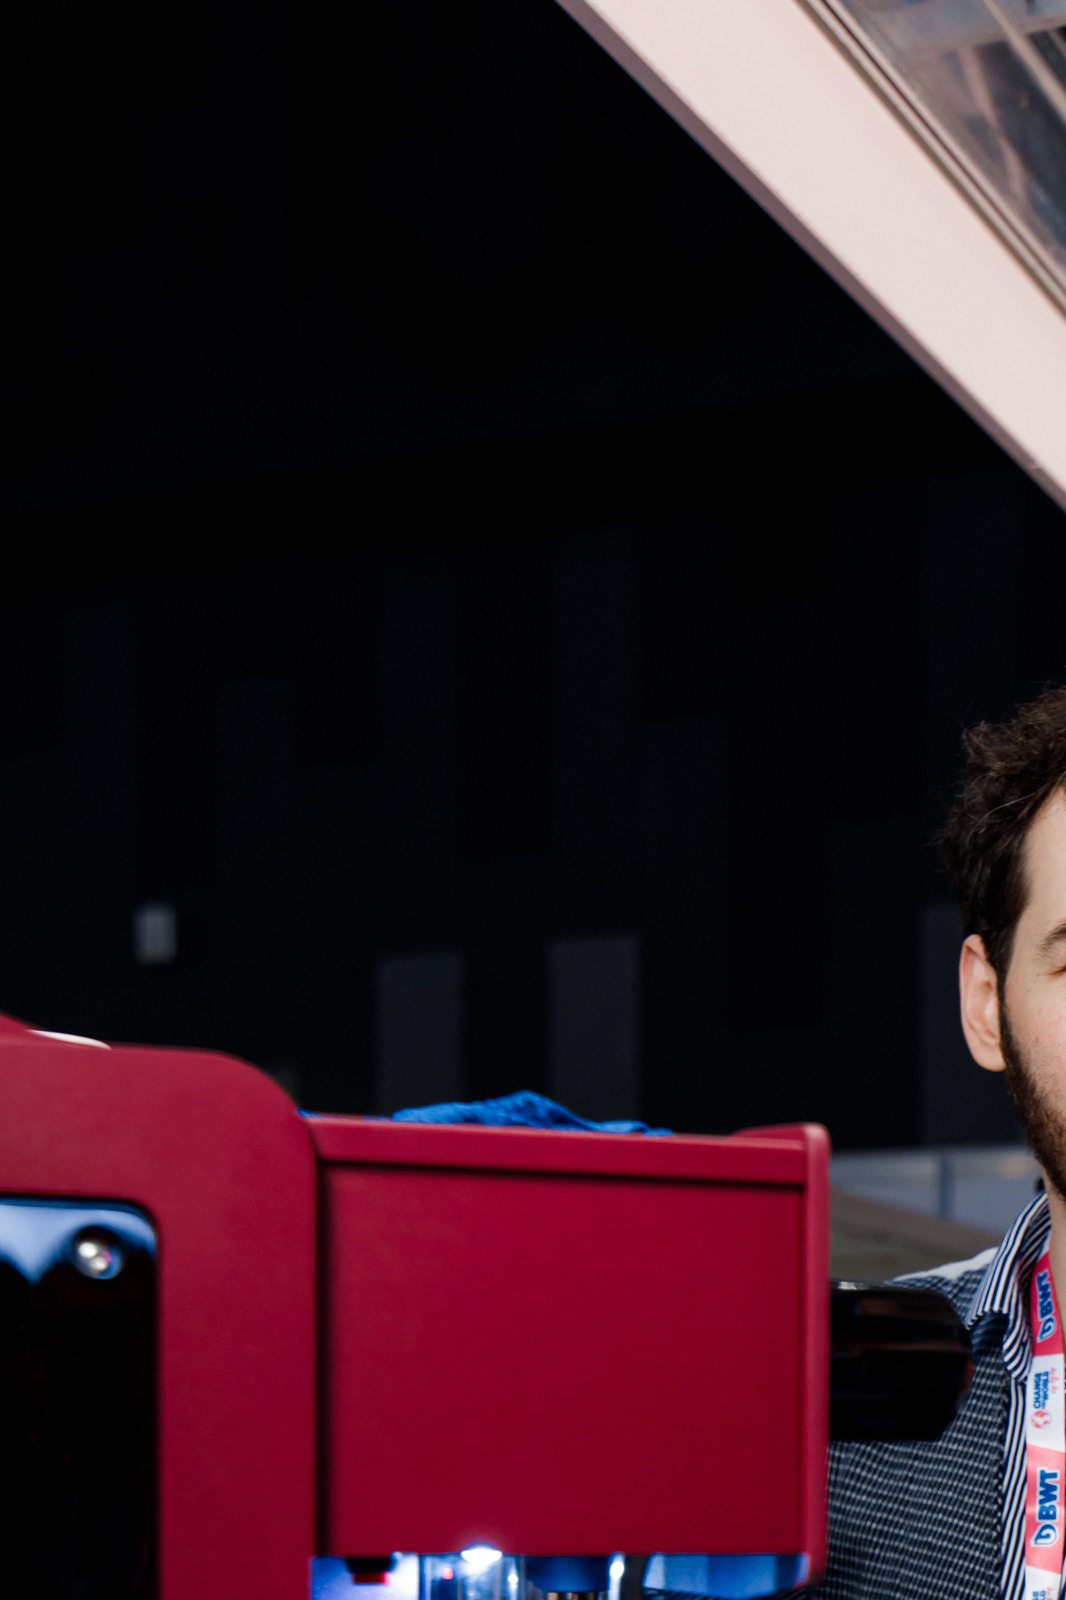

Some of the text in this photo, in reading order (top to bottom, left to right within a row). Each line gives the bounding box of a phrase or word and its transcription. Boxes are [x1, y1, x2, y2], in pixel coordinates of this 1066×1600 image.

[1036, 1270, 1054, 1321] BWT
[1033, 1373, 1042, 1409] CHANGE
[1038, 1470, 1058, 1522] BWT
